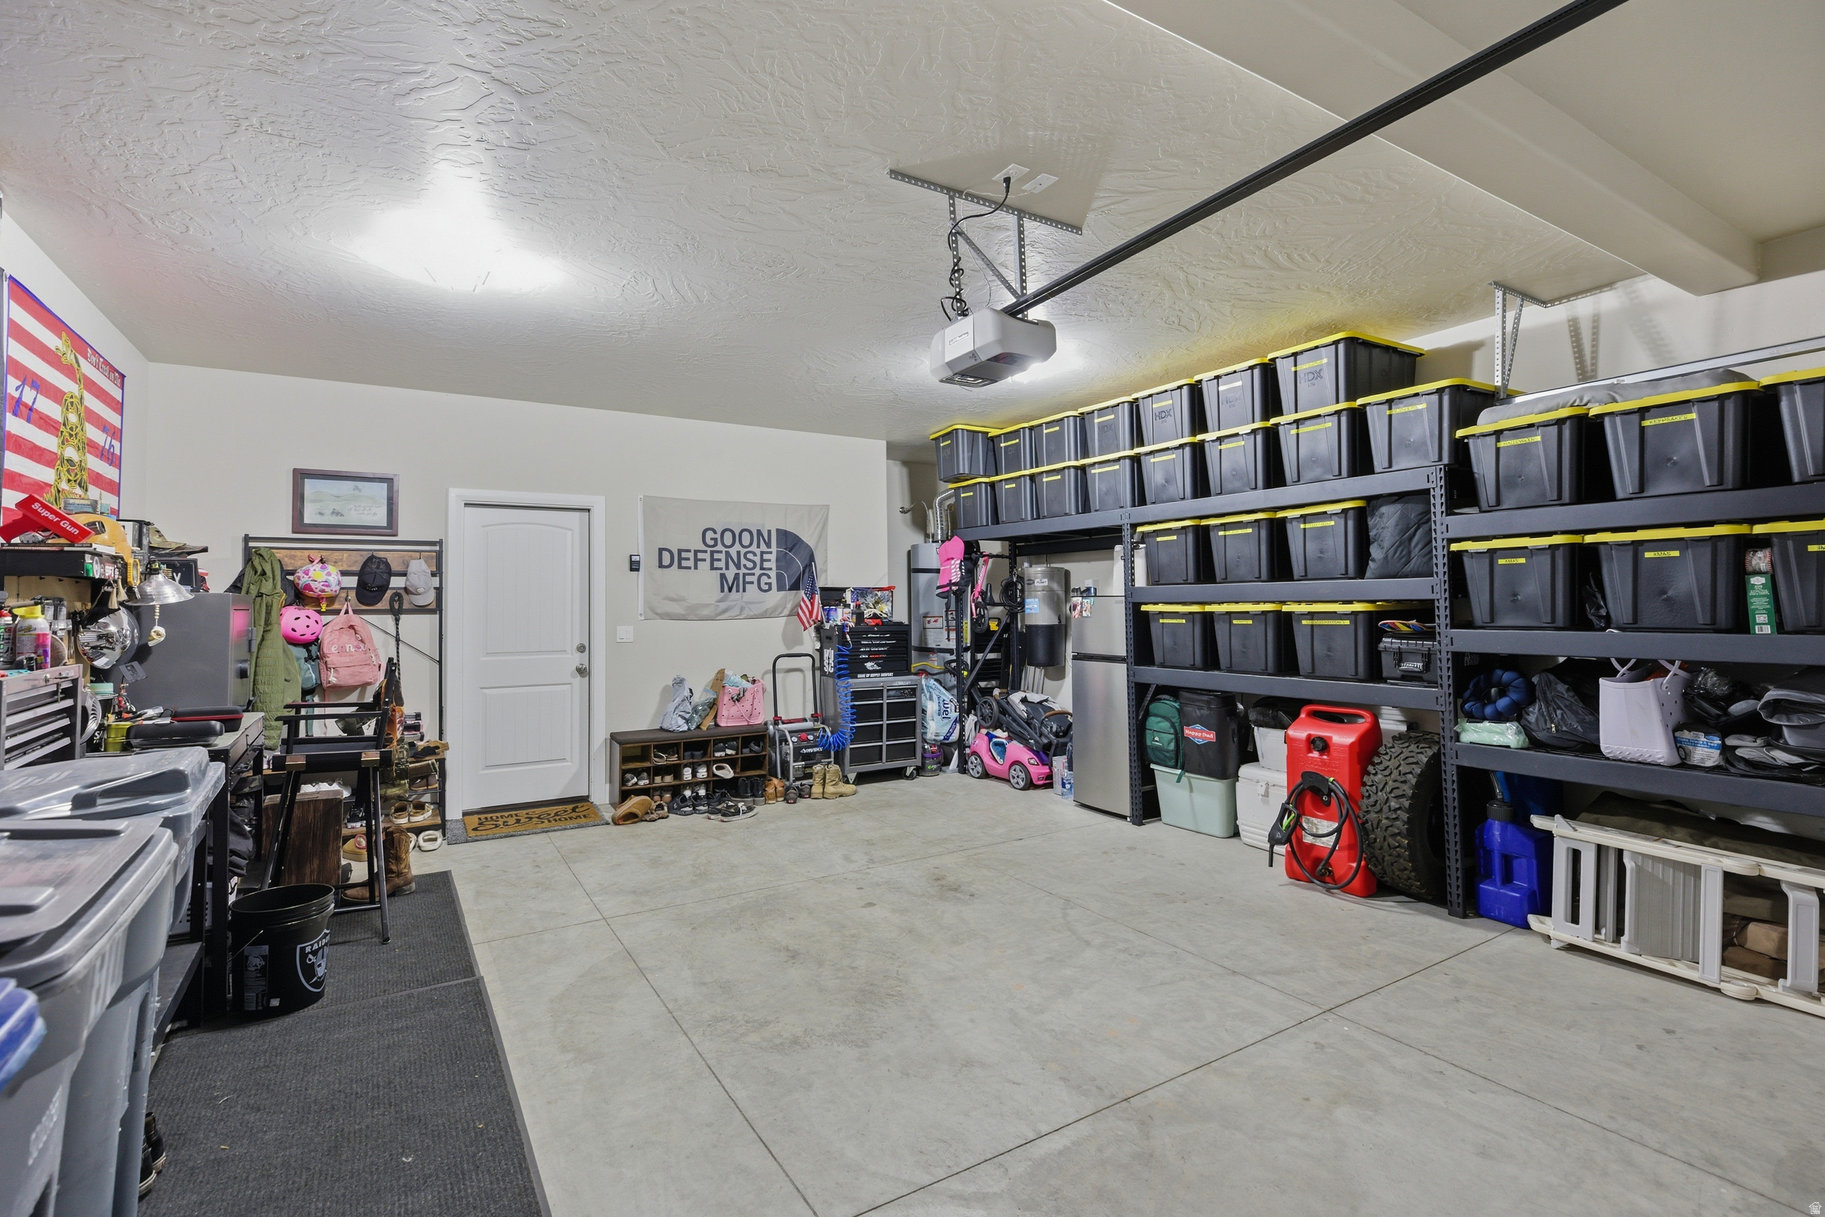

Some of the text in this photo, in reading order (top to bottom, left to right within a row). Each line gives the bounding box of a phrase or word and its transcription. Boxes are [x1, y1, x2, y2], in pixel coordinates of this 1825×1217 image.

[1298, 368, 1324, 385] HDX
[12, 374, 40, 424] 17
[1155, 408, 1172, 421] HDX
[100, 423, 116, 467] 76
[31, 501, 61, 523] Super
[60, 520, 80, 536] Gun
[701, 527, 772, 550] GOON
[657, 547, 773, 571] DEFENSE
[719, 572, 773, 594] MFG
[477, 812, 522, 822] HOME
[546, 814, 590, 824] HOME
